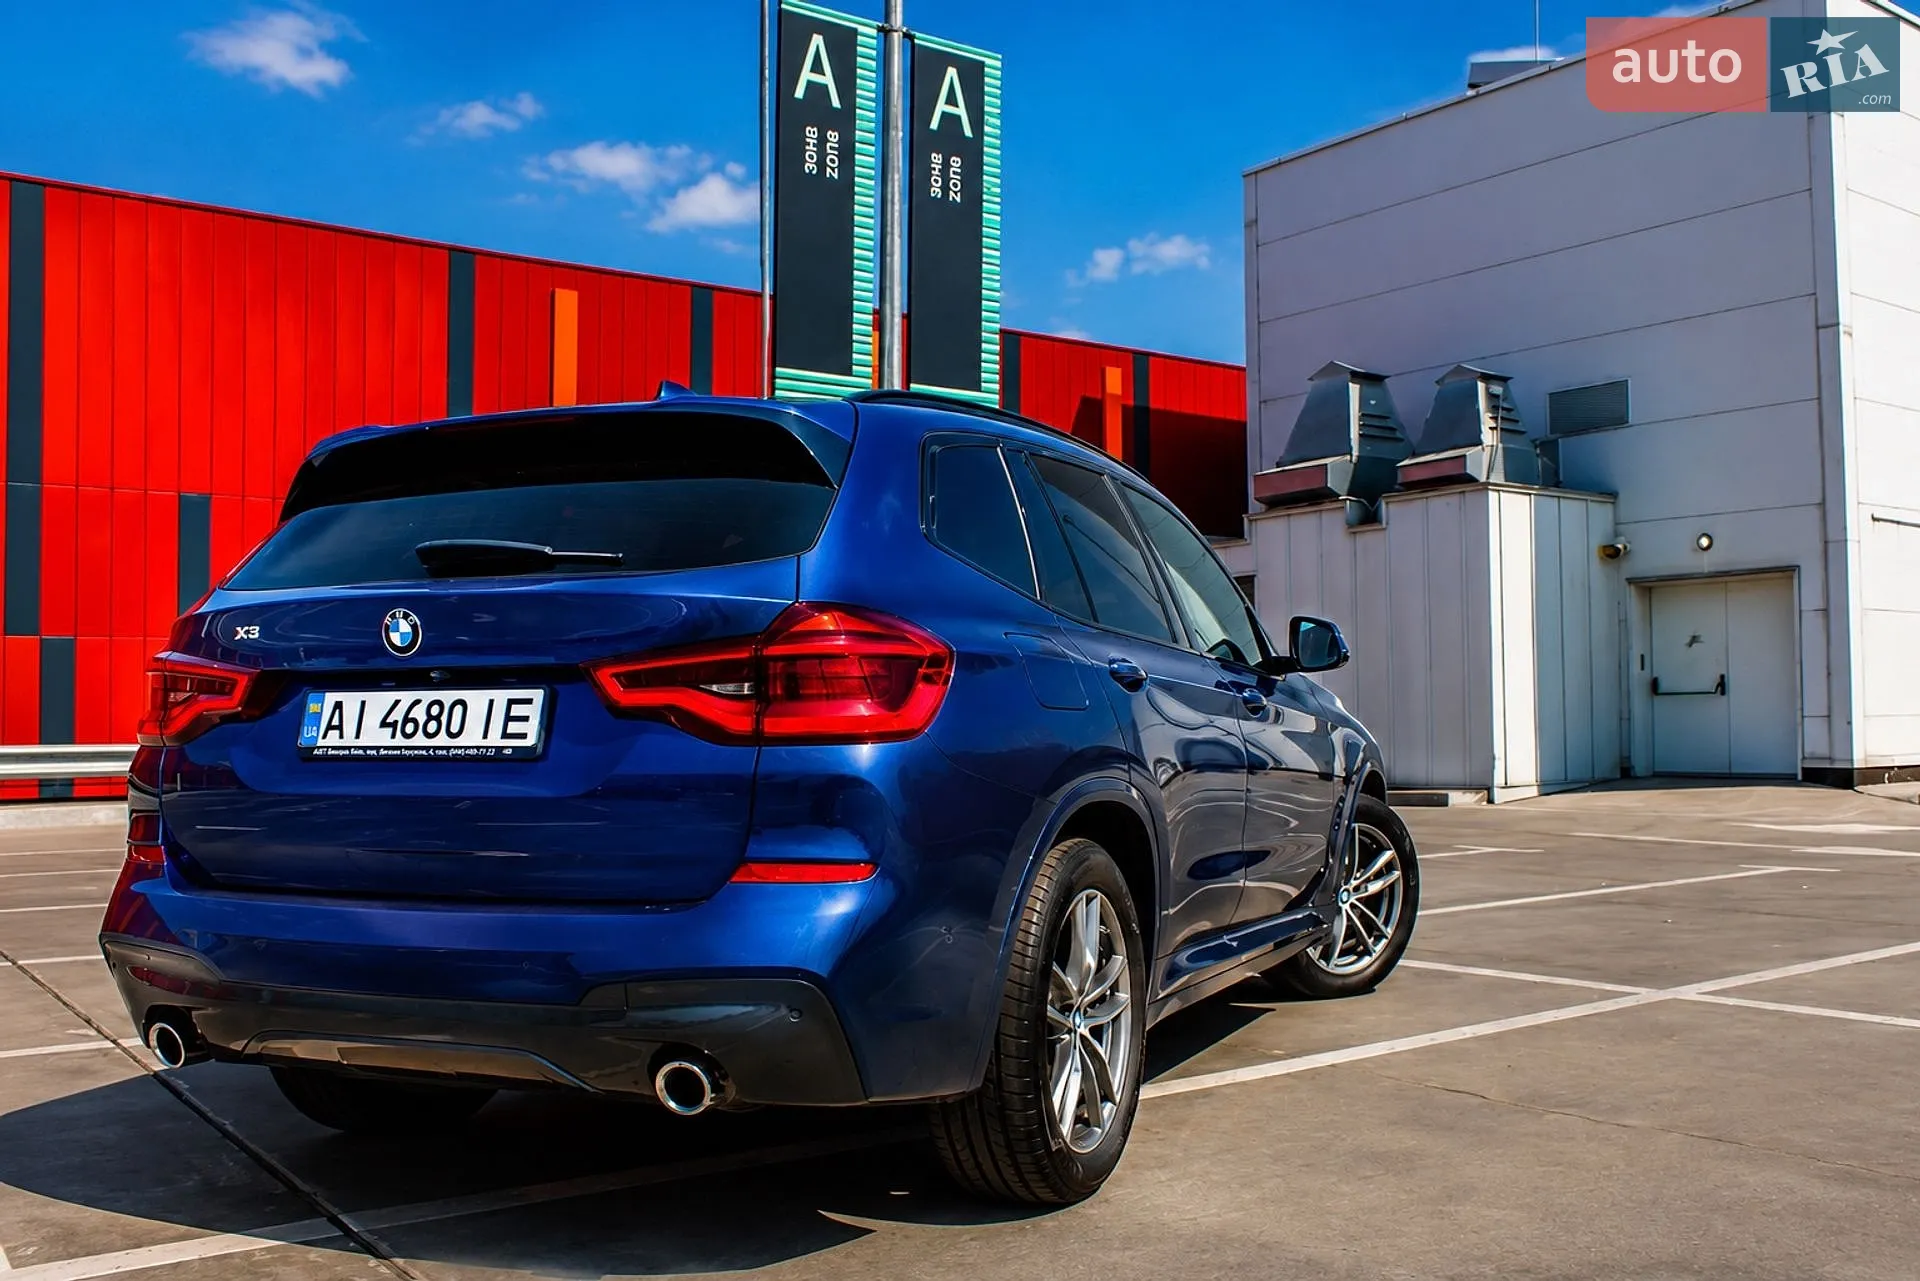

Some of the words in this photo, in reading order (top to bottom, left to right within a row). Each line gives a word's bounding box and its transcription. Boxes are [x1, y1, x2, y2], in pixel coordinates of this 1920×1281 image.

[793, 32, 842, 110] A
[929, 66, 973, 138] A
[233, 625, 261, 641] X3
[322, 699, 367, 740] AI
[379, 698, 469, 740] 4680
[482, 698, 535, 740] IE
